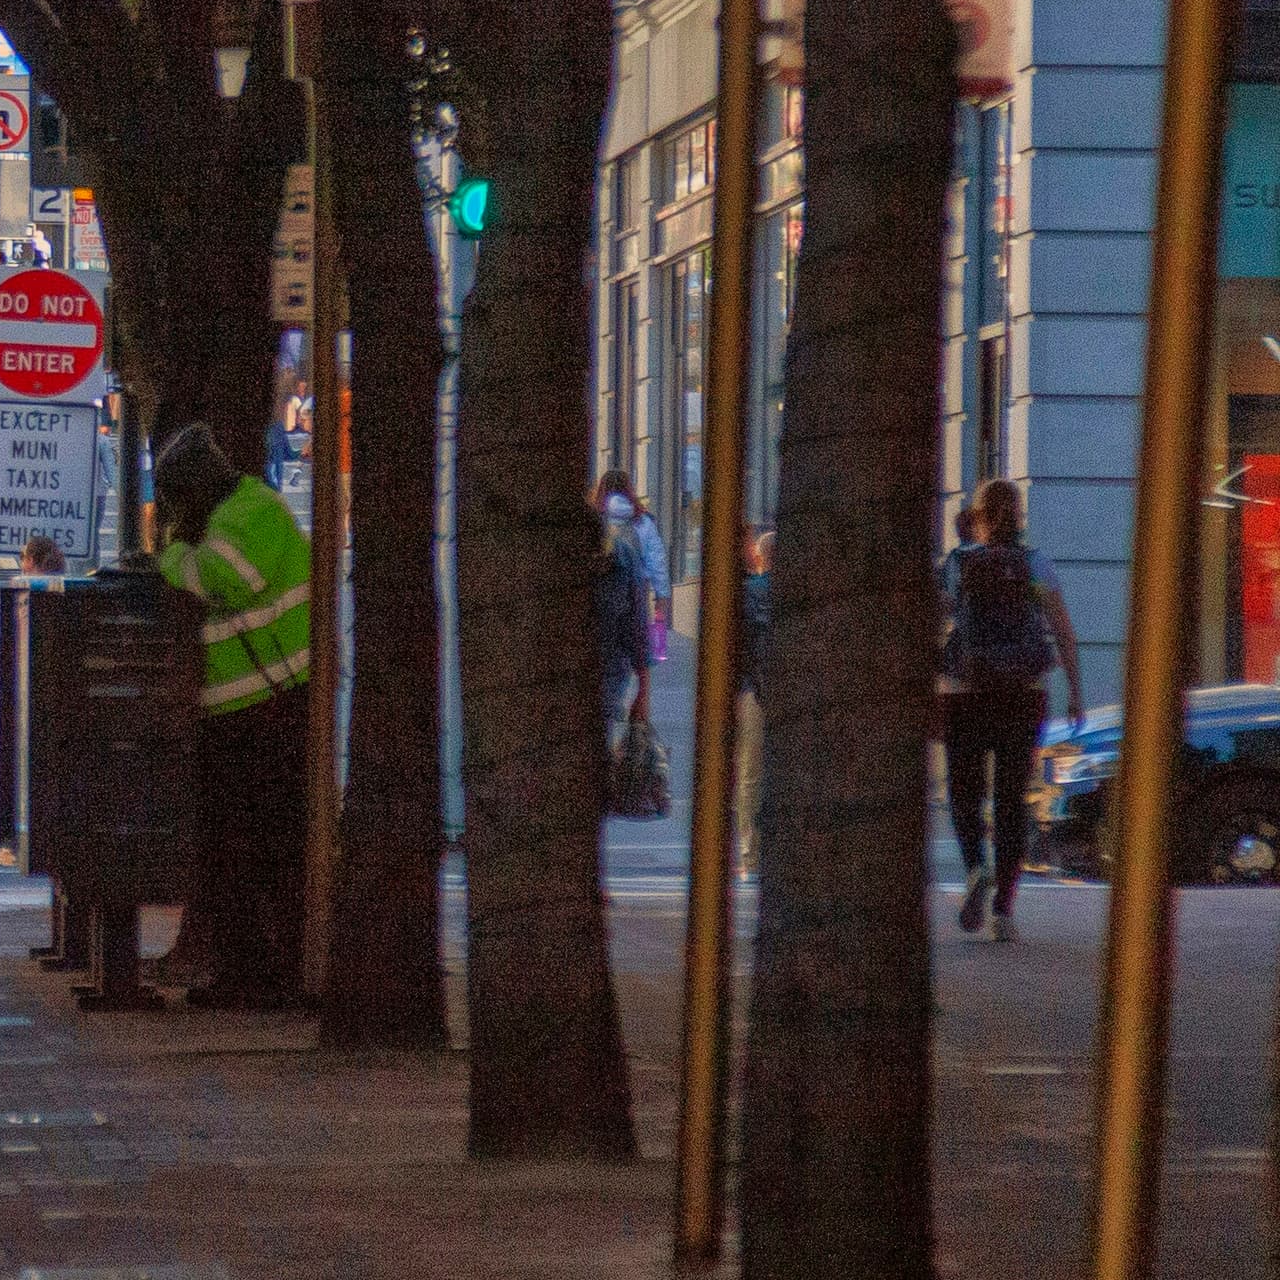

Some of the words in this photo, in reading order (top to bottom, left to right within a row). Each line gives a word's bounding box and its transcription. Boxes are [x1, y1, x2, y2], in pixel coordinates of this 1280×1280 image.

[43, 294, 89, 317] NOT
[3, 350, 75, 374] ENTER
[0, 410, 73, 433] EXCEPT
[12, 440, 58, 461] MUNI
[6, 468, 60, 491] TAXIS
